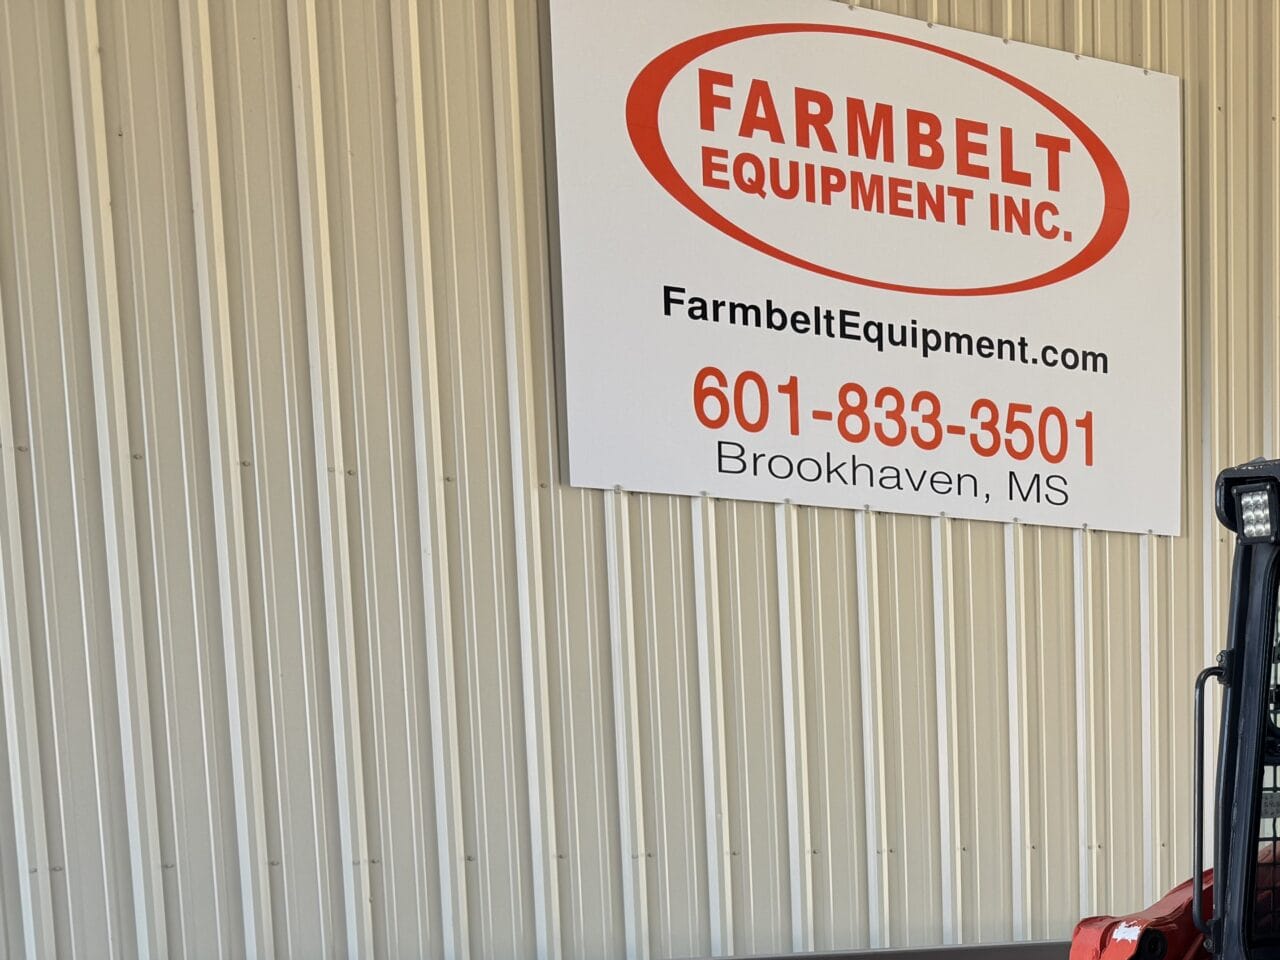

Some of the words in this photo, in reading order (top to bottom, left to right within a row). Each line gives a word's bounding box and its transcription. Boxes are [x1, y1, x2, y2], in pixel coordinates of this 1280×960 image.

[698, 68, 1071, 193] FARMBELT
[701, 146, 975, 226] EQUIPMENT
[989, 193, 1073, 242] INC.
[662, 285, 1109, 374] FarmbeltEquipment.com
[692, 365, 1094, 467] 601-833-3501
[716, 440, 991, 504] Brookhaven,
[1007, 470, 1070, 506] MS
